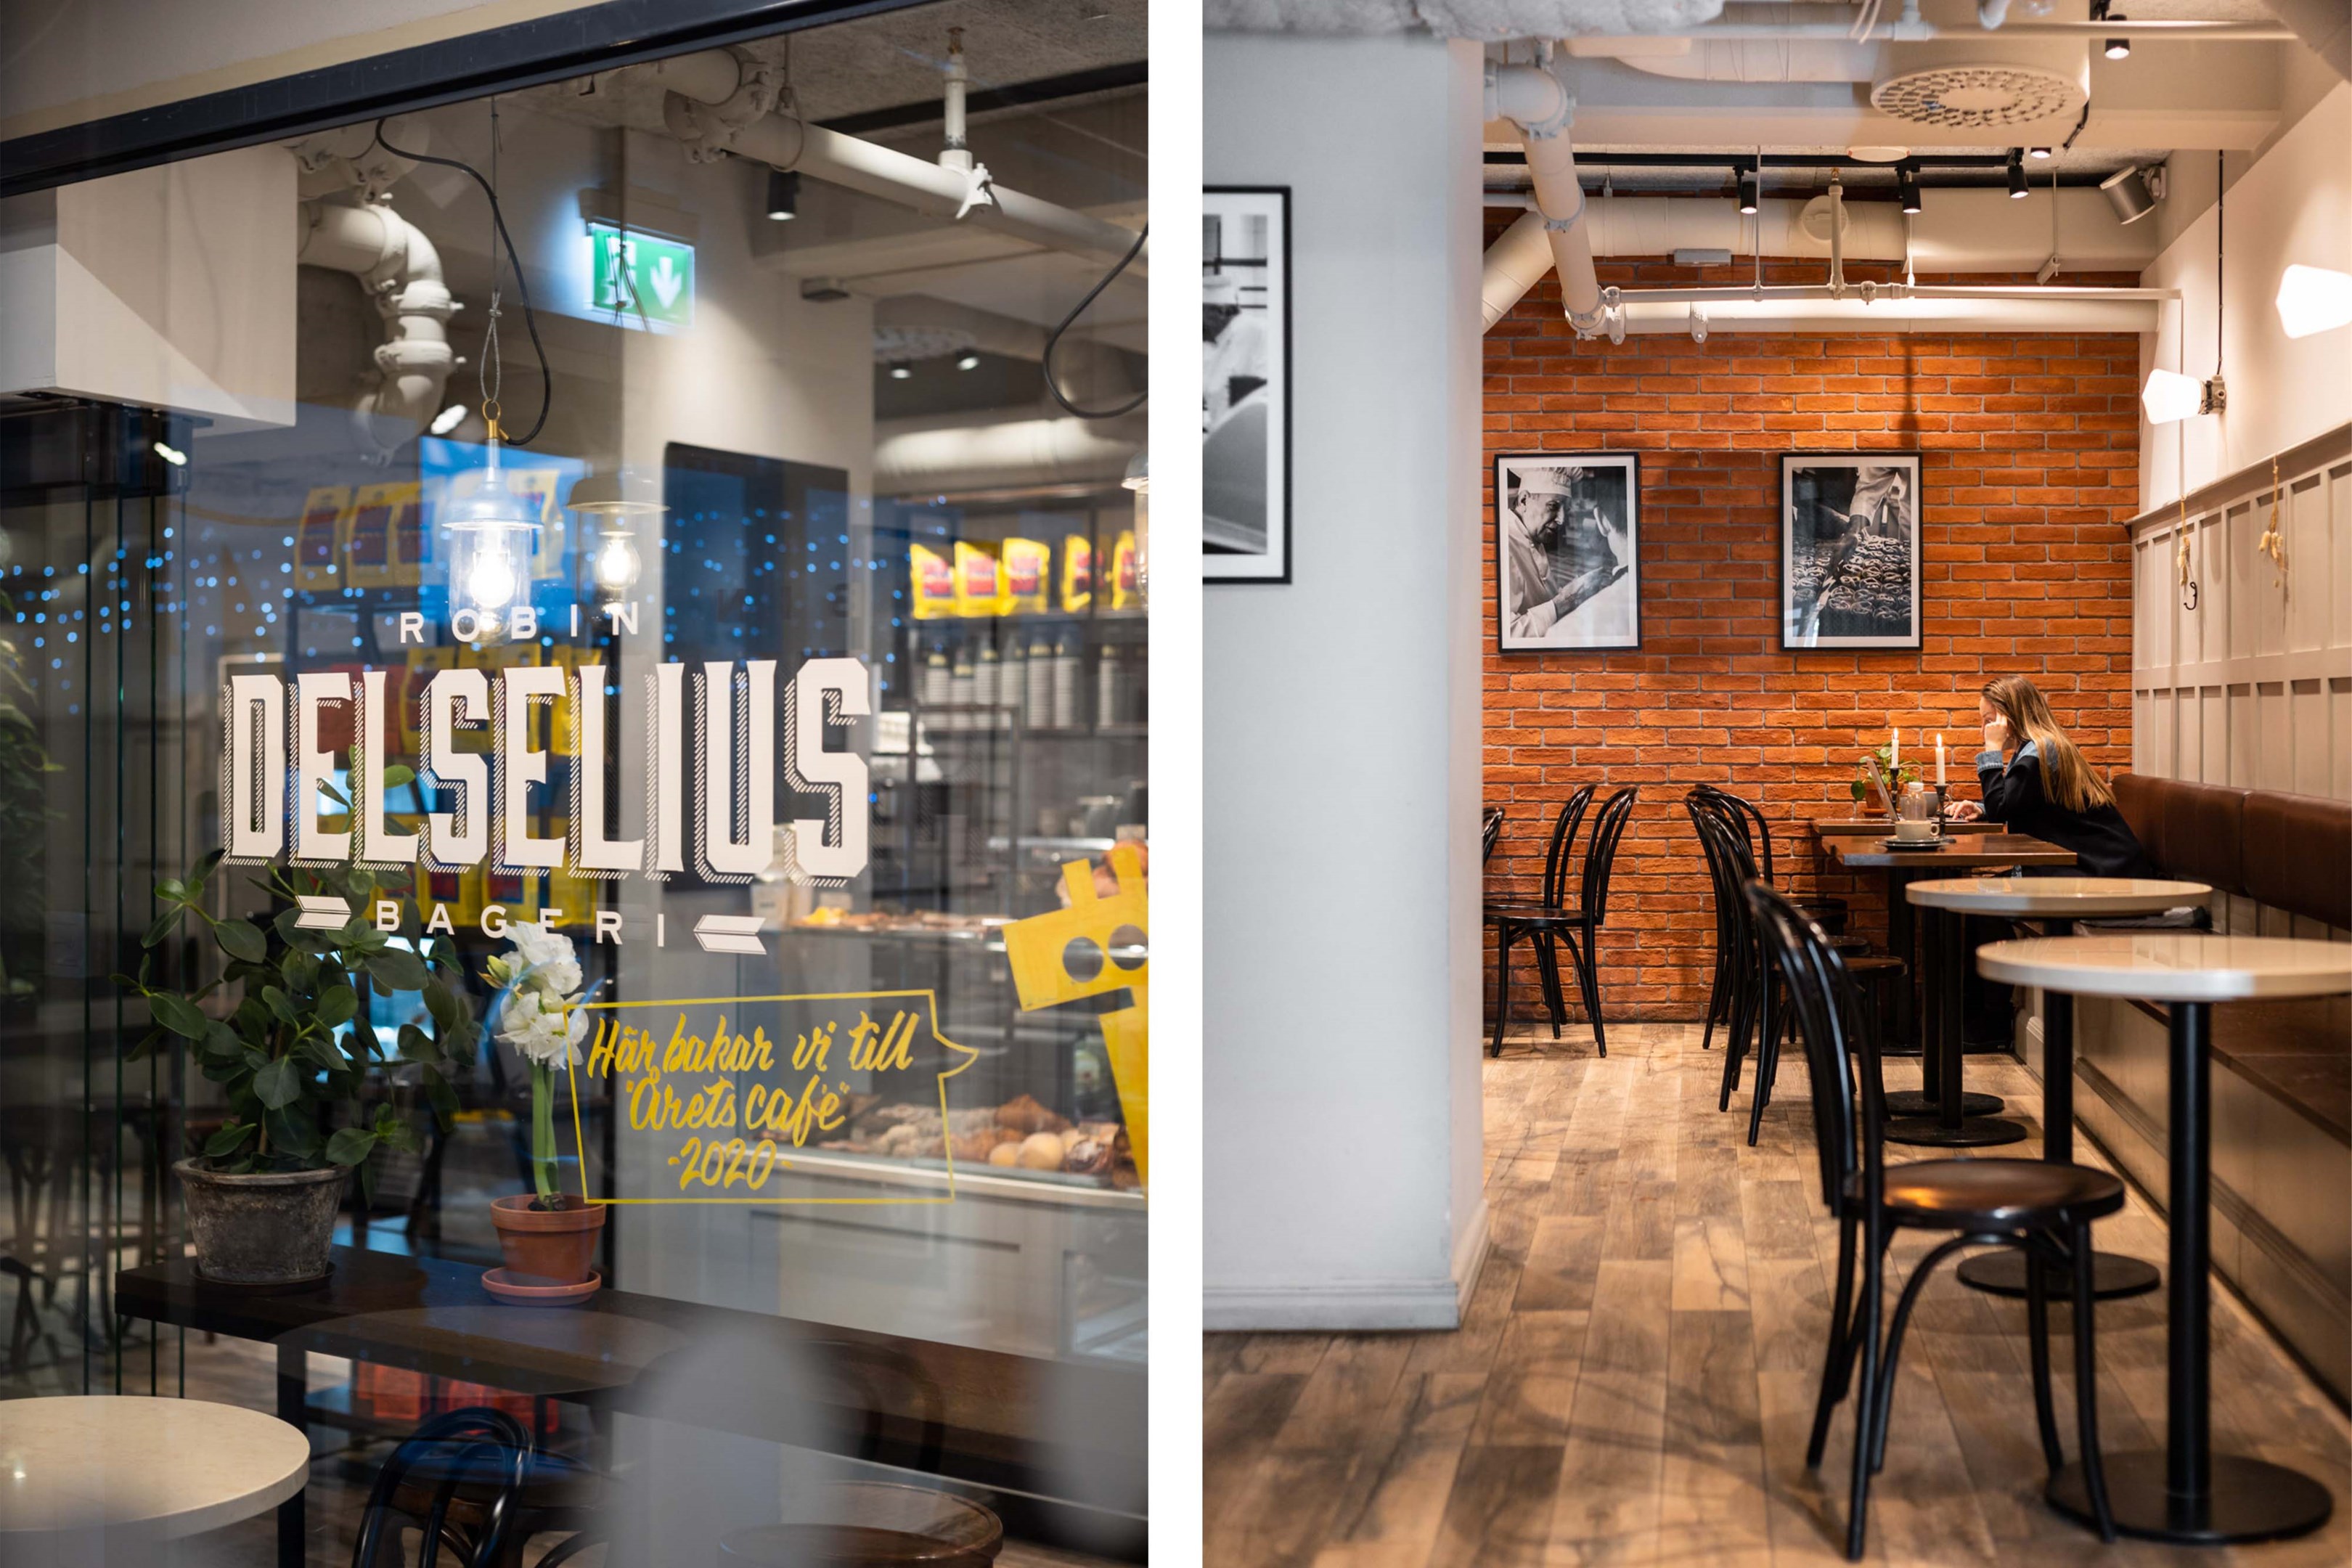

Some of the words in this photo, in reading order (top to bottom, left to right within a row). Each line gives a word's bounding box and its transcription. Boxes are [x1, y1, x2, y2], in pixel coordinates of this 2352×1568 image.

[400, 601, 638, 643] ROBIN
[224, 658, 871, 887] DELSELIUS
[377, 899, 665, 948] BAGERI
[587, 1017, 657, 1079] Här
[661, 1012, 775, 1072] bakar
[791, 1021, 837, 1072] vi
[848, 1010, 920, 1072] till
